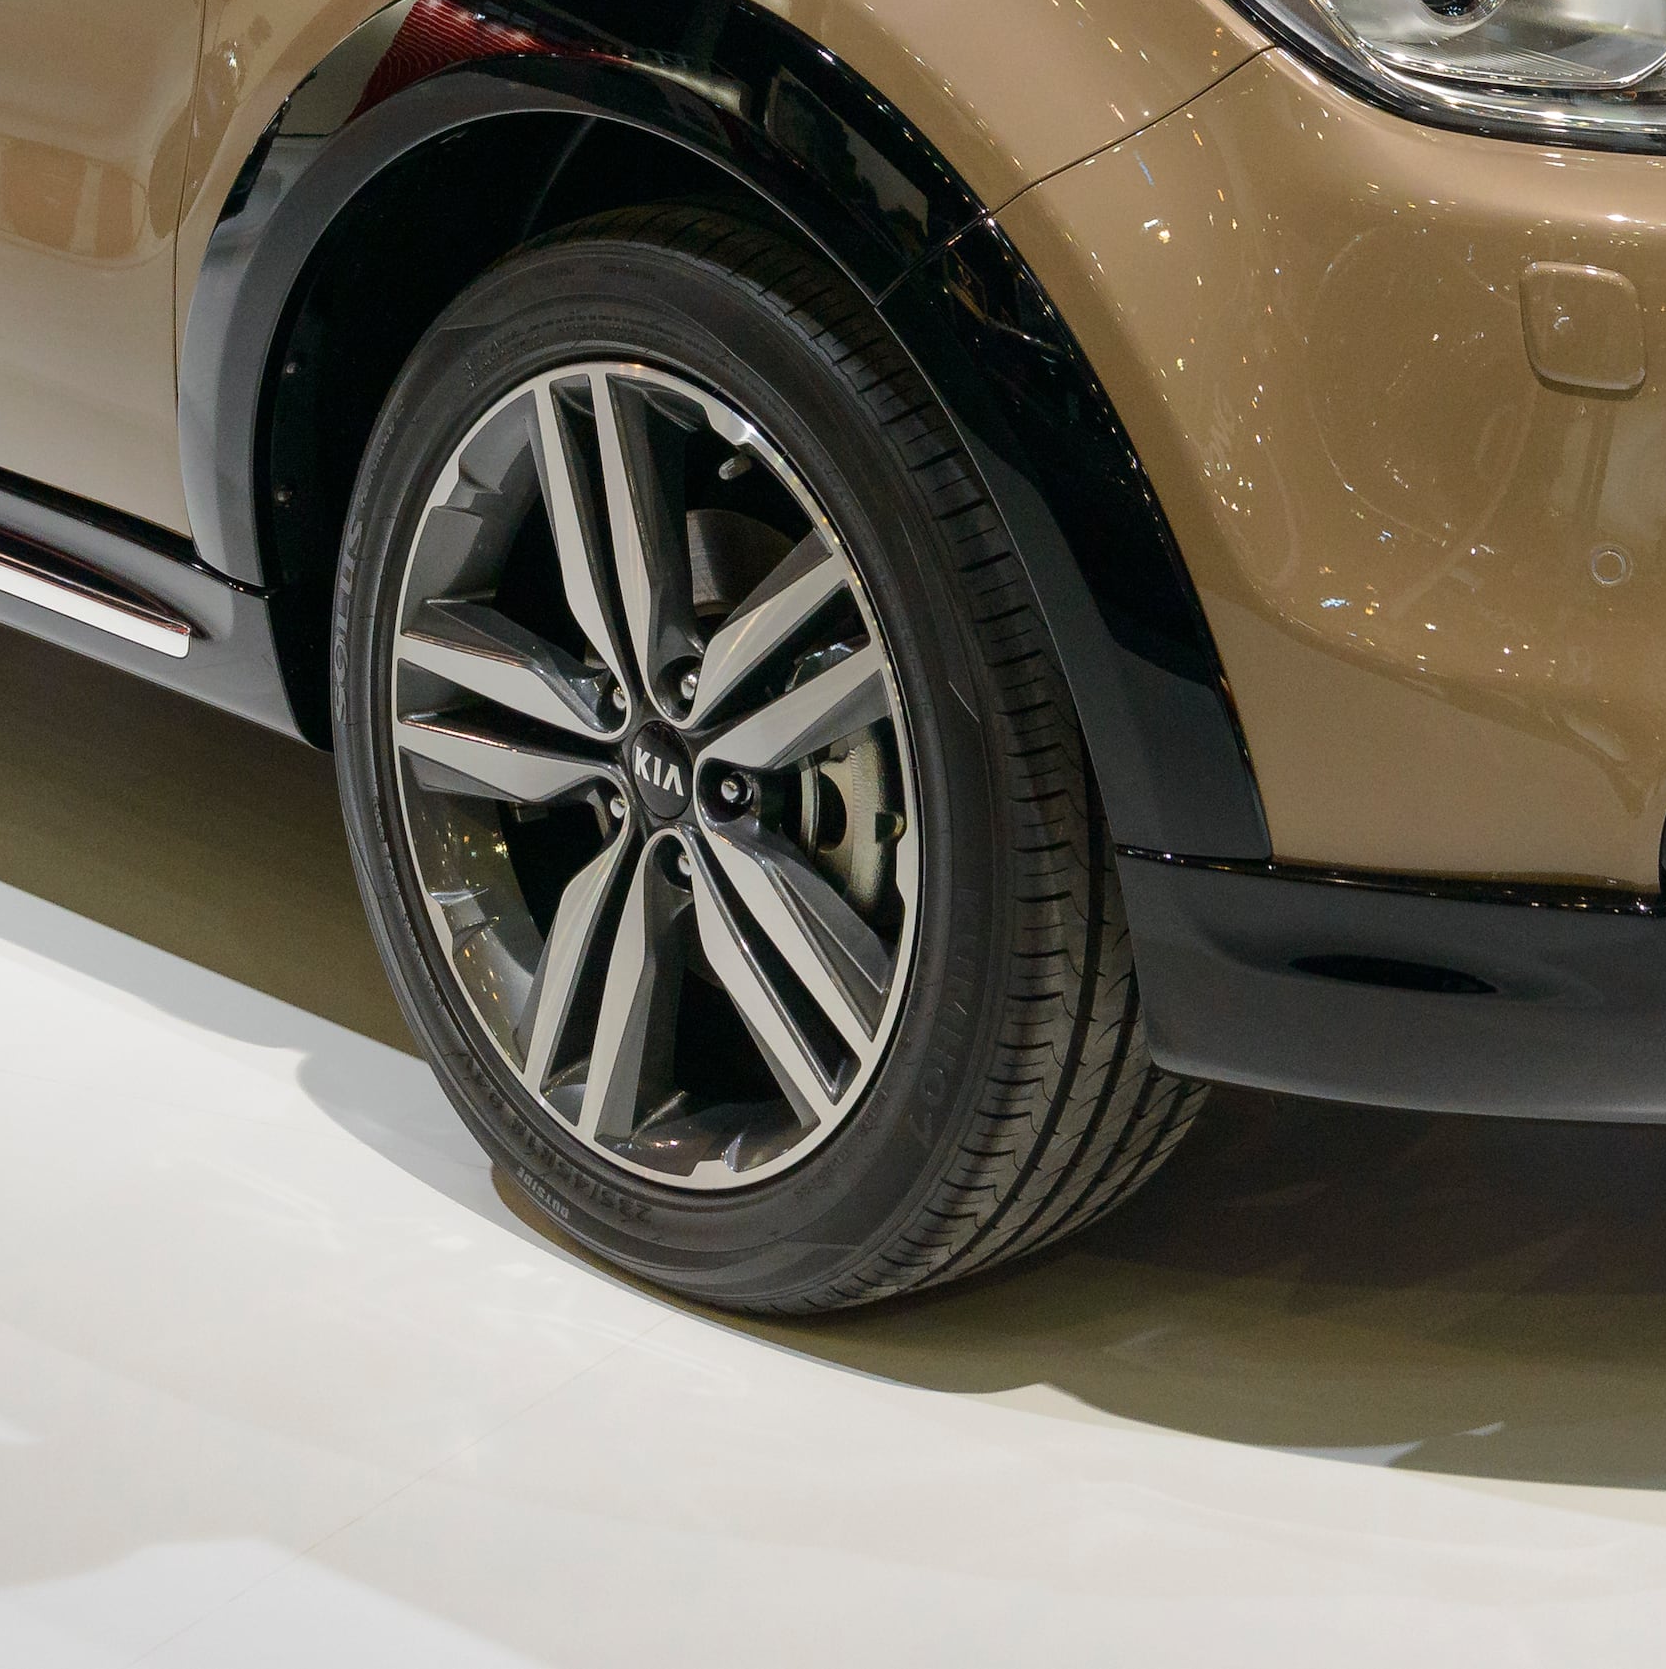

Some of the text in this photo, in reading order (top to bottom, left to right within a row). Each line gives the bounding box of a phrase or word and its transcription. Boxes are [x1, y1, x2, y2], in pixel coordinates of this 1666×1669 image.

[334, 517, 364, 723] SOLUS
[634, 746, 685, 797] KIA
[516, 1166, 571, 1221] OUTSIDE
